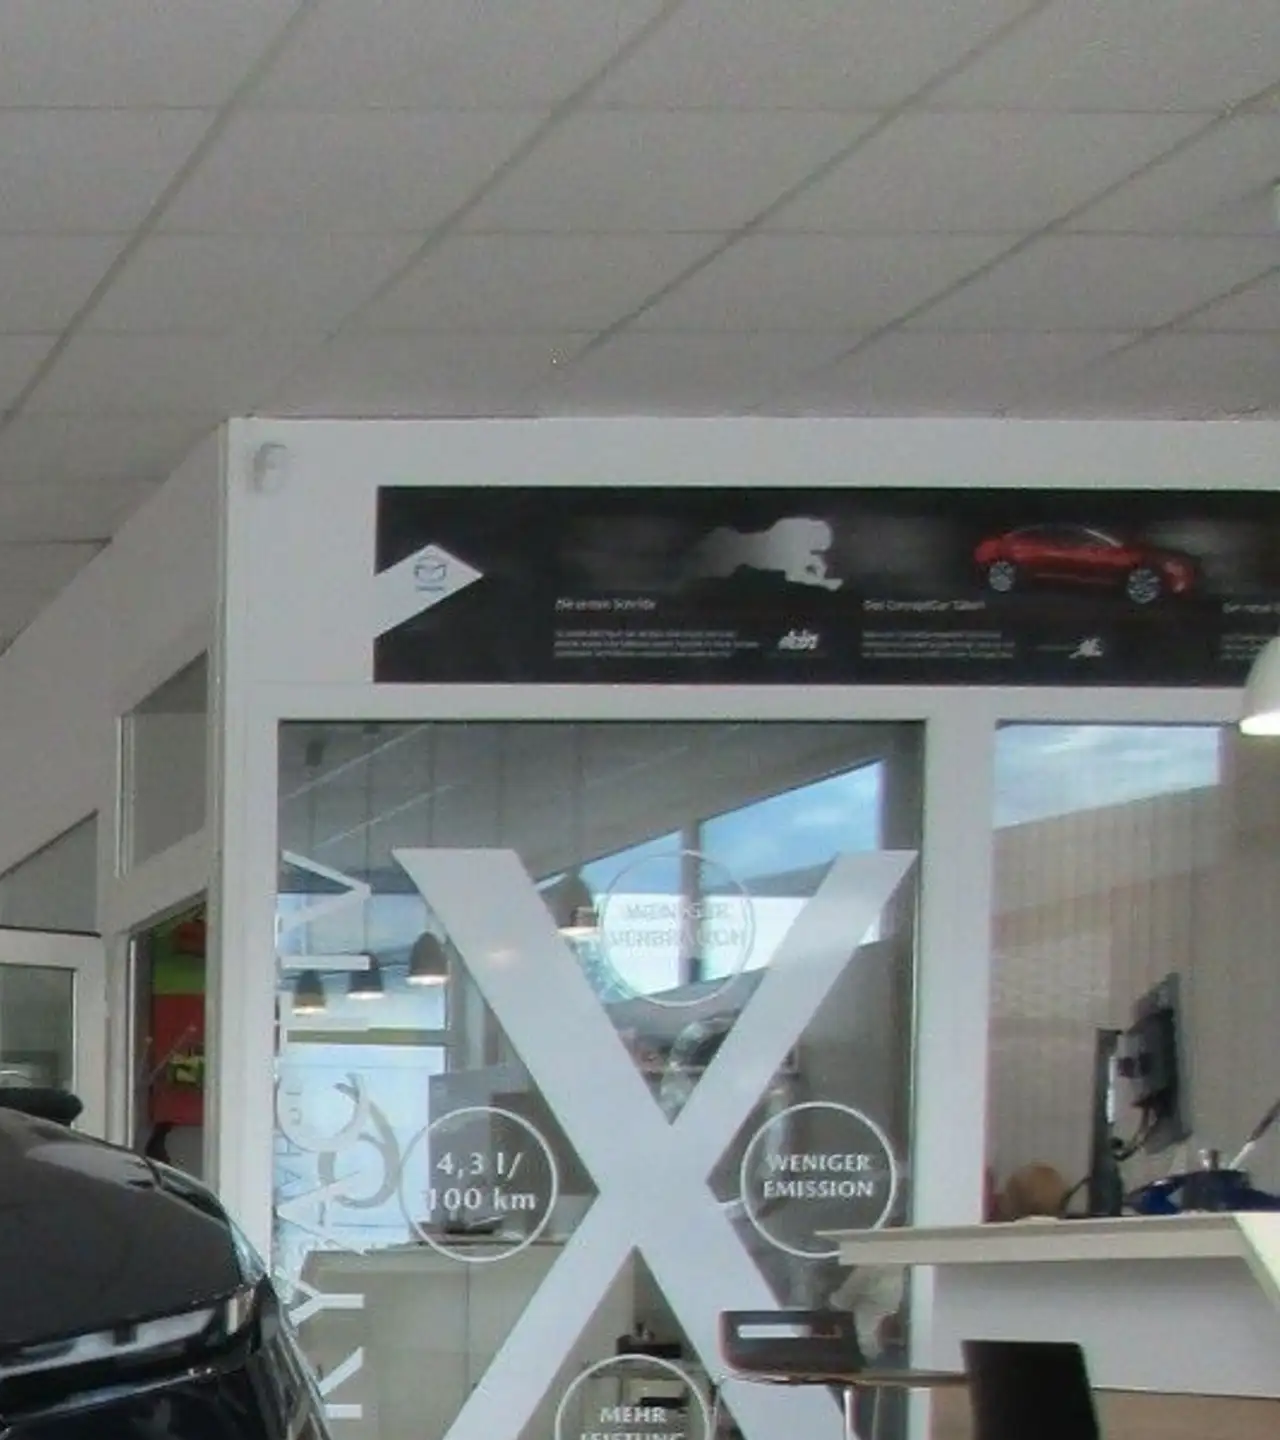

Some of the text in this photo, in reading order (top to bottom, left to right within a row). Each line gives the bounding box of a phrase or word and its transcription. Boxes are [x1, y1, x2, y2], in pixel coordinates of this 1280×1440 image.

[437, 1152, 484, 1180] 4,3
[767, 1154, 871, 1173] WENIGER
[423, 1187, 537, 1211] 100 km
[763, 1181, 875, 1199] EMISSION
[599, 1406, 669, 1423] MEHR
